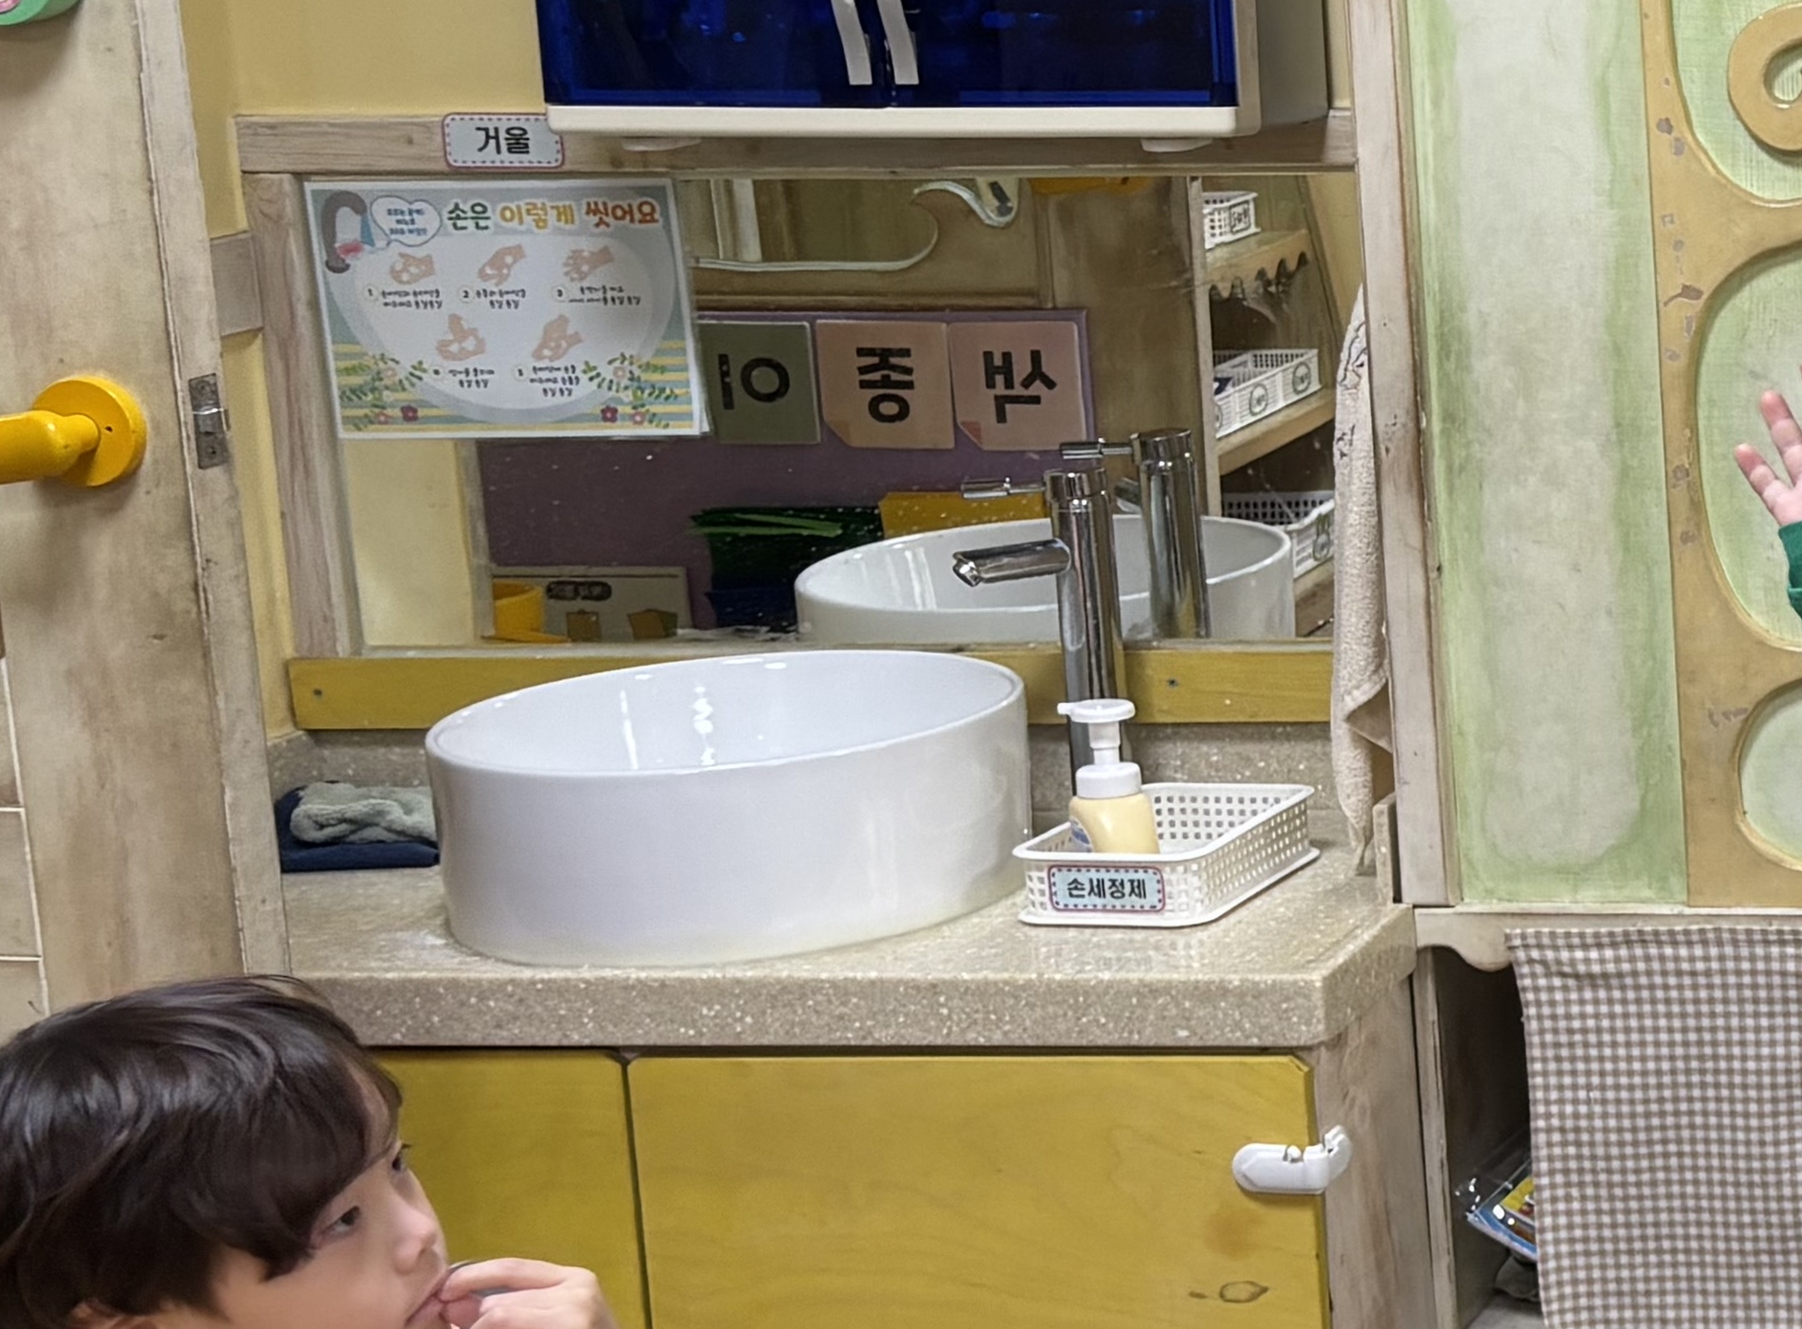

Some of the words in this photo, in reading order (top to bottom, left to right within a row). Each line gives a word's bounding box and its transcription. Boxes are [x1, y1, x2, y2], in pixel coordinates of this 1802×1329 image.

[475, 126, 530, 155] 거울
[447, 202, 491, 231] 손은
[500, 202, 576, 230] 이렇게
[585, 201, 660, 228] 씻어요
[1066, 877, 1148, 900] 손세정제
